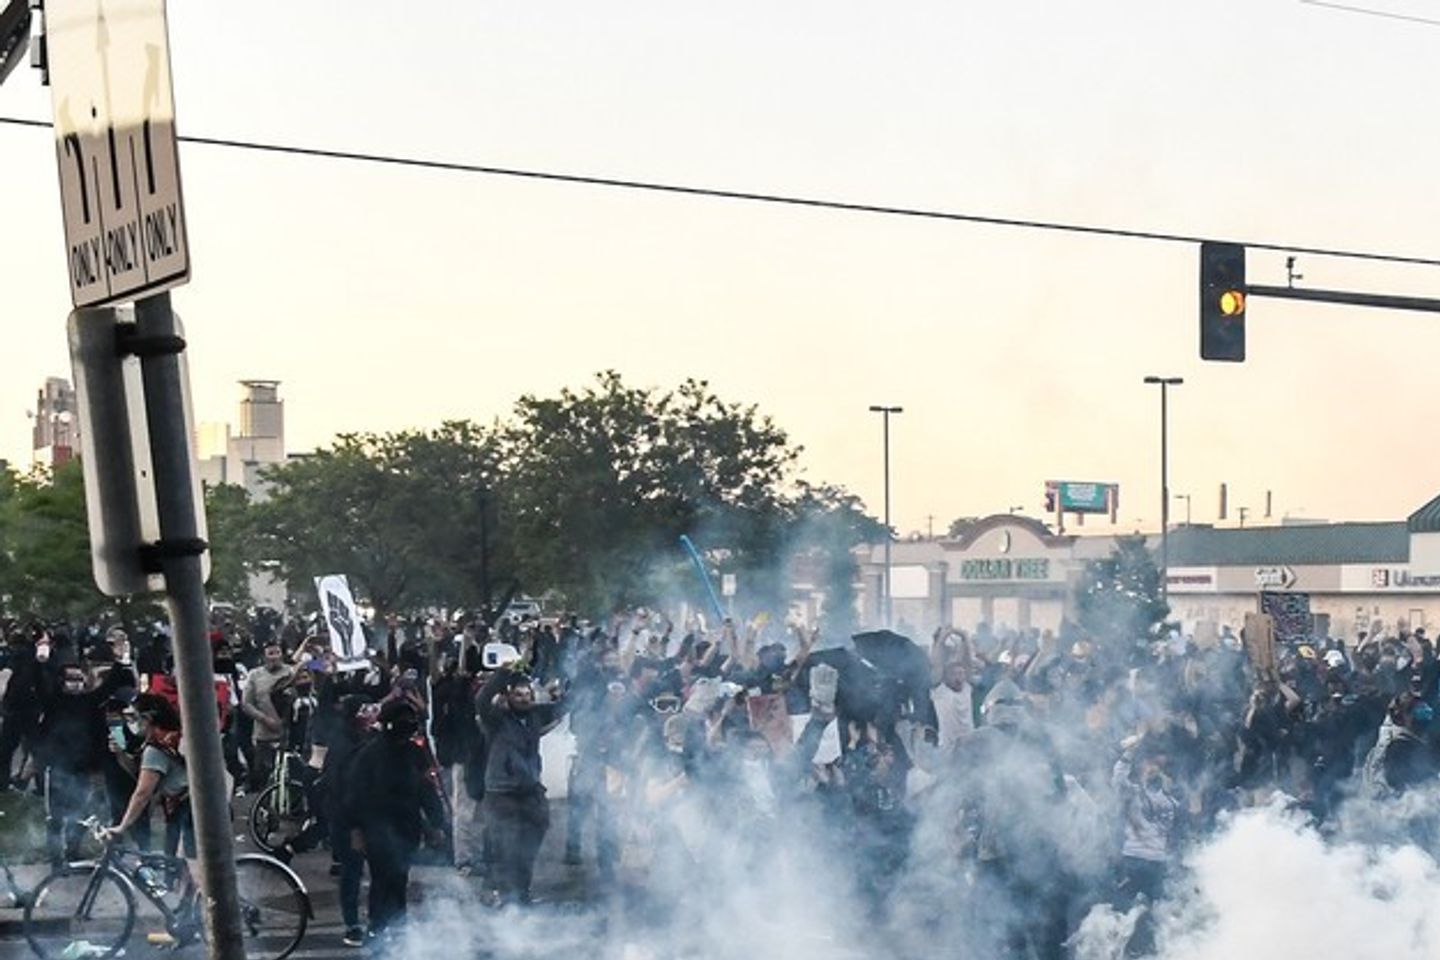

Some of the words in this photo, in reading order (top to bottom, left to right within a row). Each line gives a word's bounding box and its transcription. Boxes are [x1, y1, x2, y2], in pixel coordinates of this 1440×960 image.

[108, 220, 138, 275] ONLY
[146, 203, 178, 262] ONLY
[72, 236, 101, 288] ONLY
